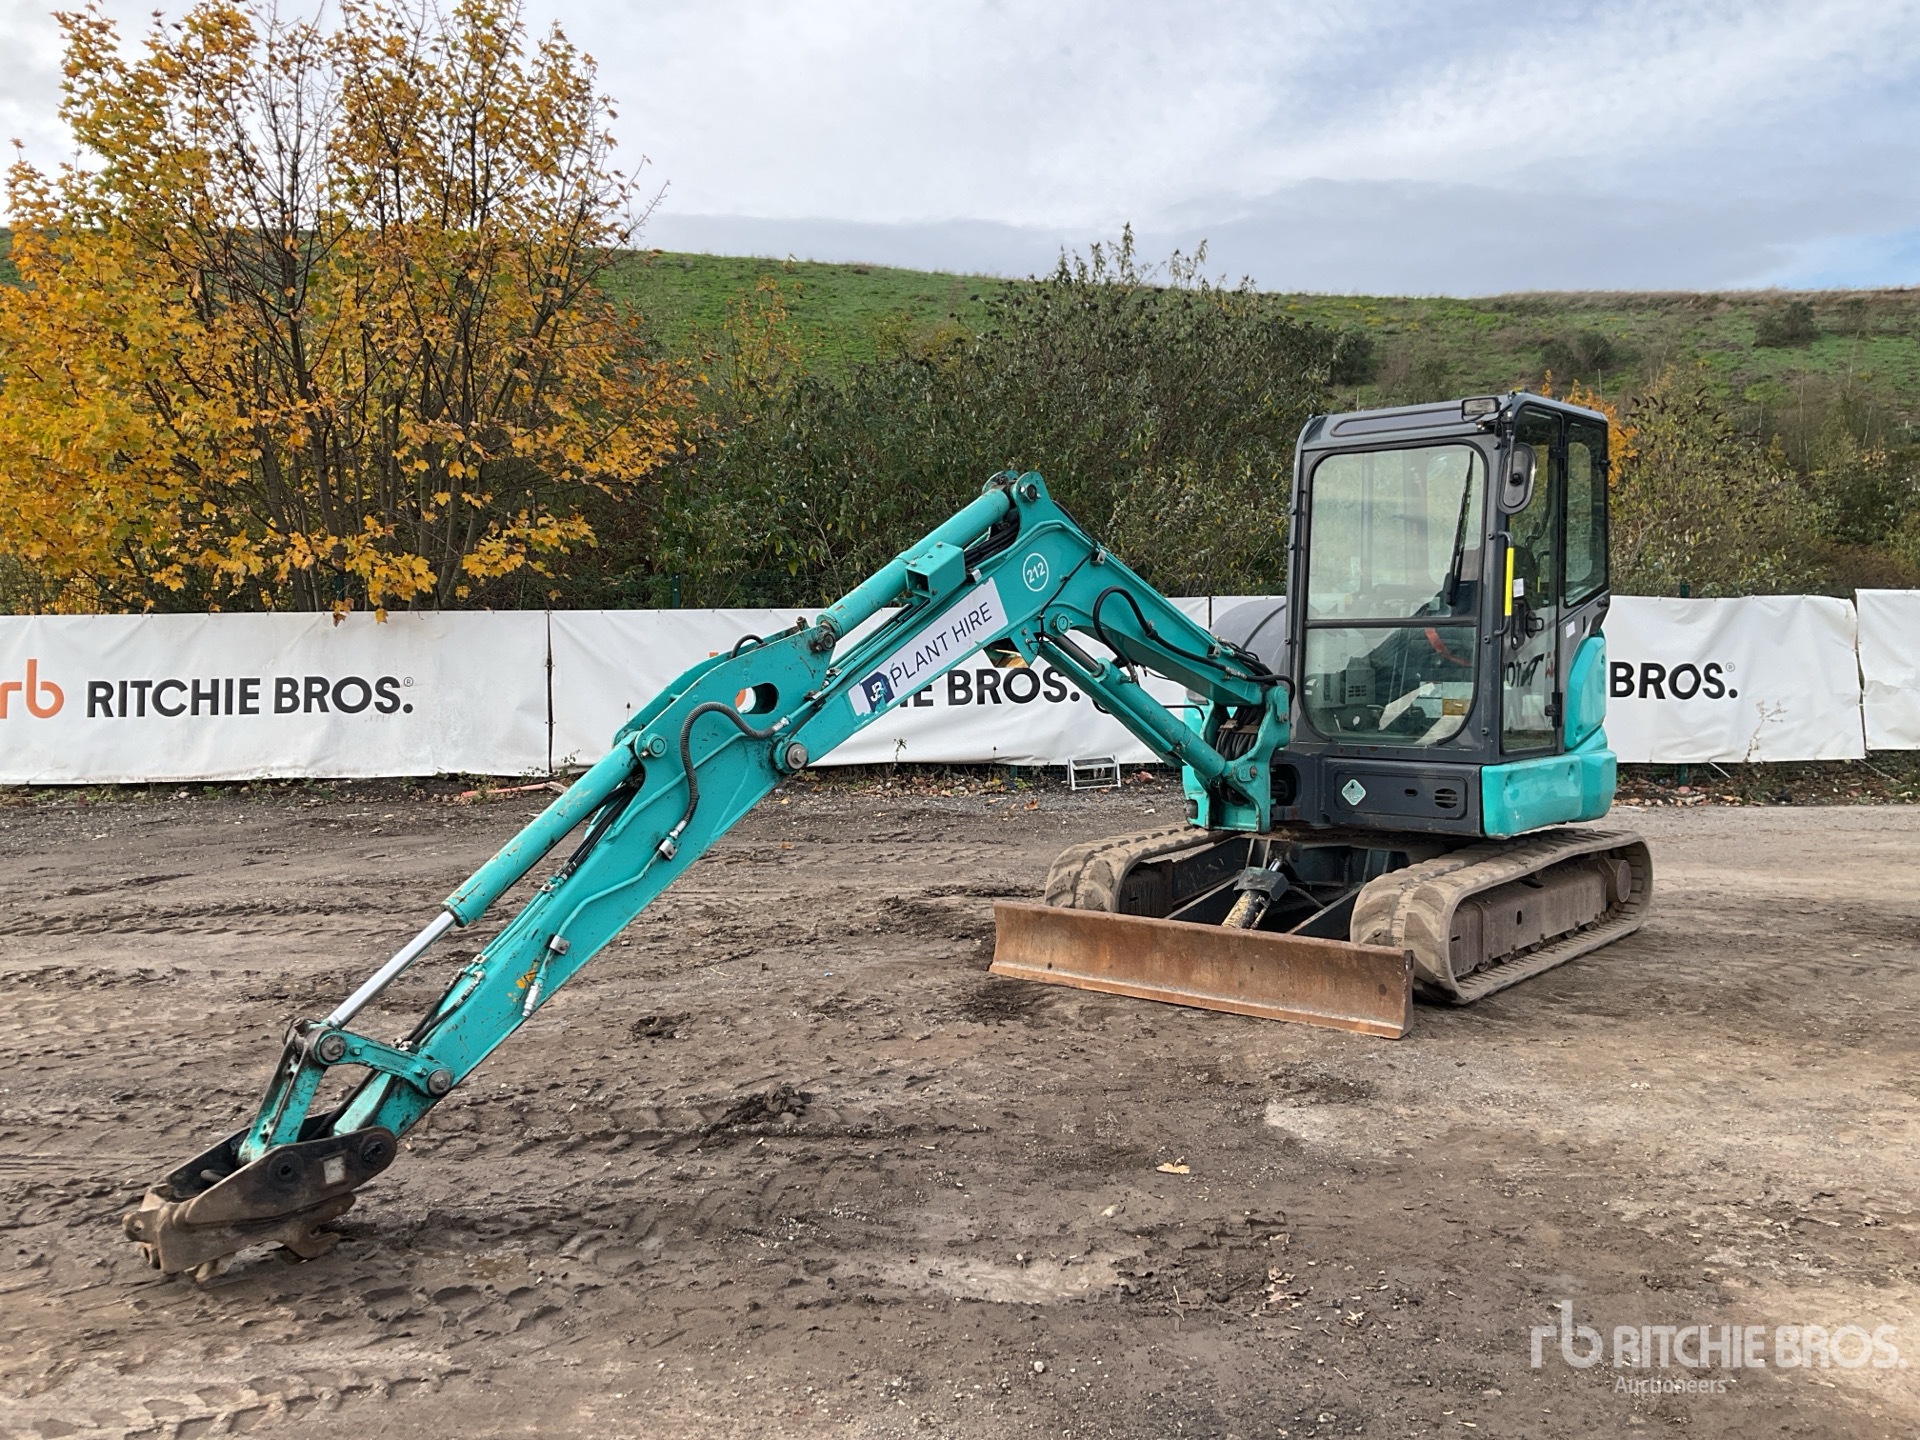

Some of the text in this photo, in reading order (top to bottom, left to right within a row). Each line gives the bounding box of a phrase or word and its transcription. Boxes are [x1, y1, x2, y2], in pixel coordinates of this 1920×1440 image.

[1026, 562, 1046, 584] 212
[889, 601, 993, 688] PLANT HIRE
[87, 677, 261, 718] RITCHIE
[947, 667, 1081, 706] BROS.
